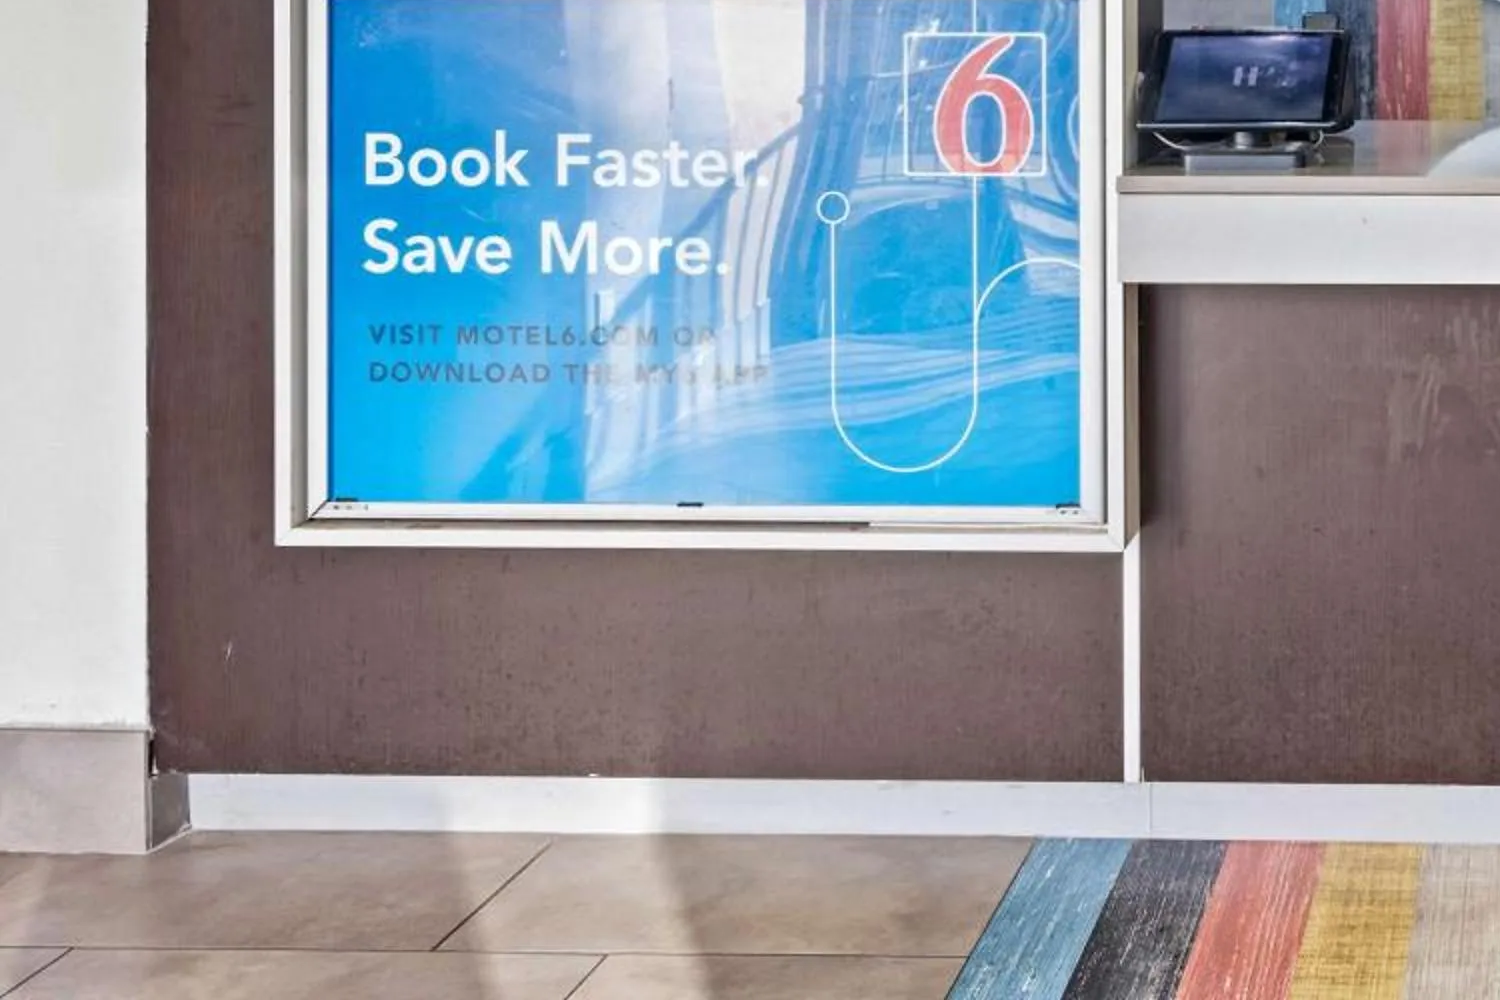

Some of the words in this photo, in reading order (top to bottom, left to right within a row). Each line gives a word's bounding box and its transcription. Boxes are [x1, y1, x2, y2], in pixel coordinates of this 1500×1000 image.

[932, 33, 1034, 177] 6
[364, 129, 531, 187] Book
[556, 132, 770, 187] Faster.
[361, 217, 513, 275] Save
[540, 220, 731, 275] More.
[368, 324, 442, 346] VISIT
[456, 325, 659, 347] MOTEL6.COM
[368, 361, 551, 384] DOWNLOAD
